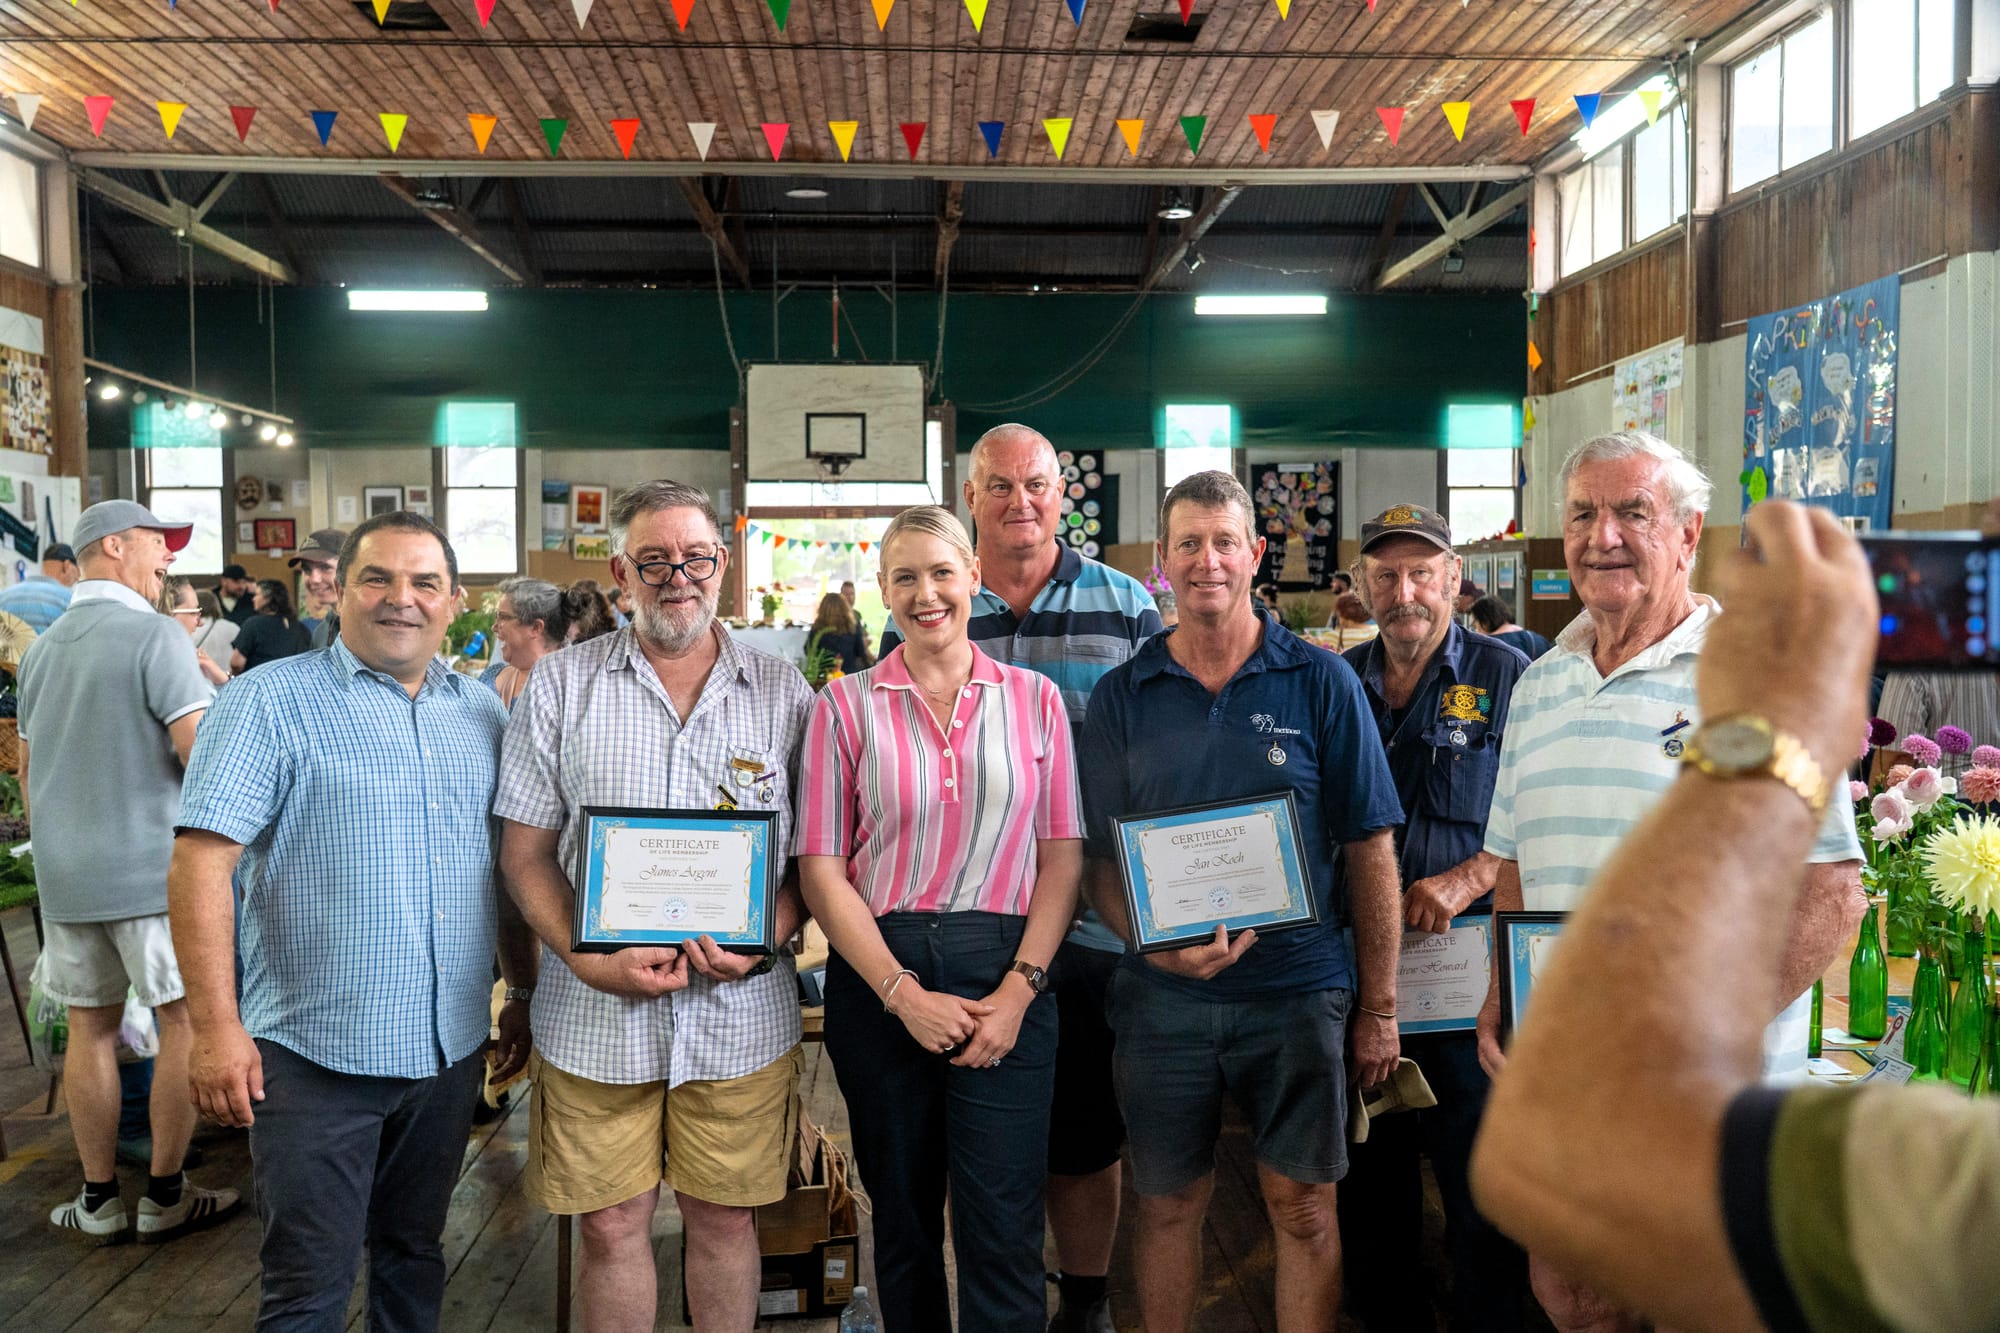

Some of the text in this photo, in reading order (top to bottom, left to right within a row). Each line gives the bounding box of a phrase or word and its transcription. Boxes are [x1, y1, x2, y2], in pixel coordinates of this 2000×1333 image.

[1268, 541, 1326, 558] Beling
[1272, 555, 1324, 571] Leing
[1171, 825, 1247, 845] CERTIFICATE
[1203, 837, 1237, 846] MEMBERSHIP
[639, 838, 720, 850] CERTIFICATE
[639, 864, 718, 882] James Argent
[1401, 936, 1457, 950] TIFICATE
[1396, 959, 1469, 976] drew Howard
